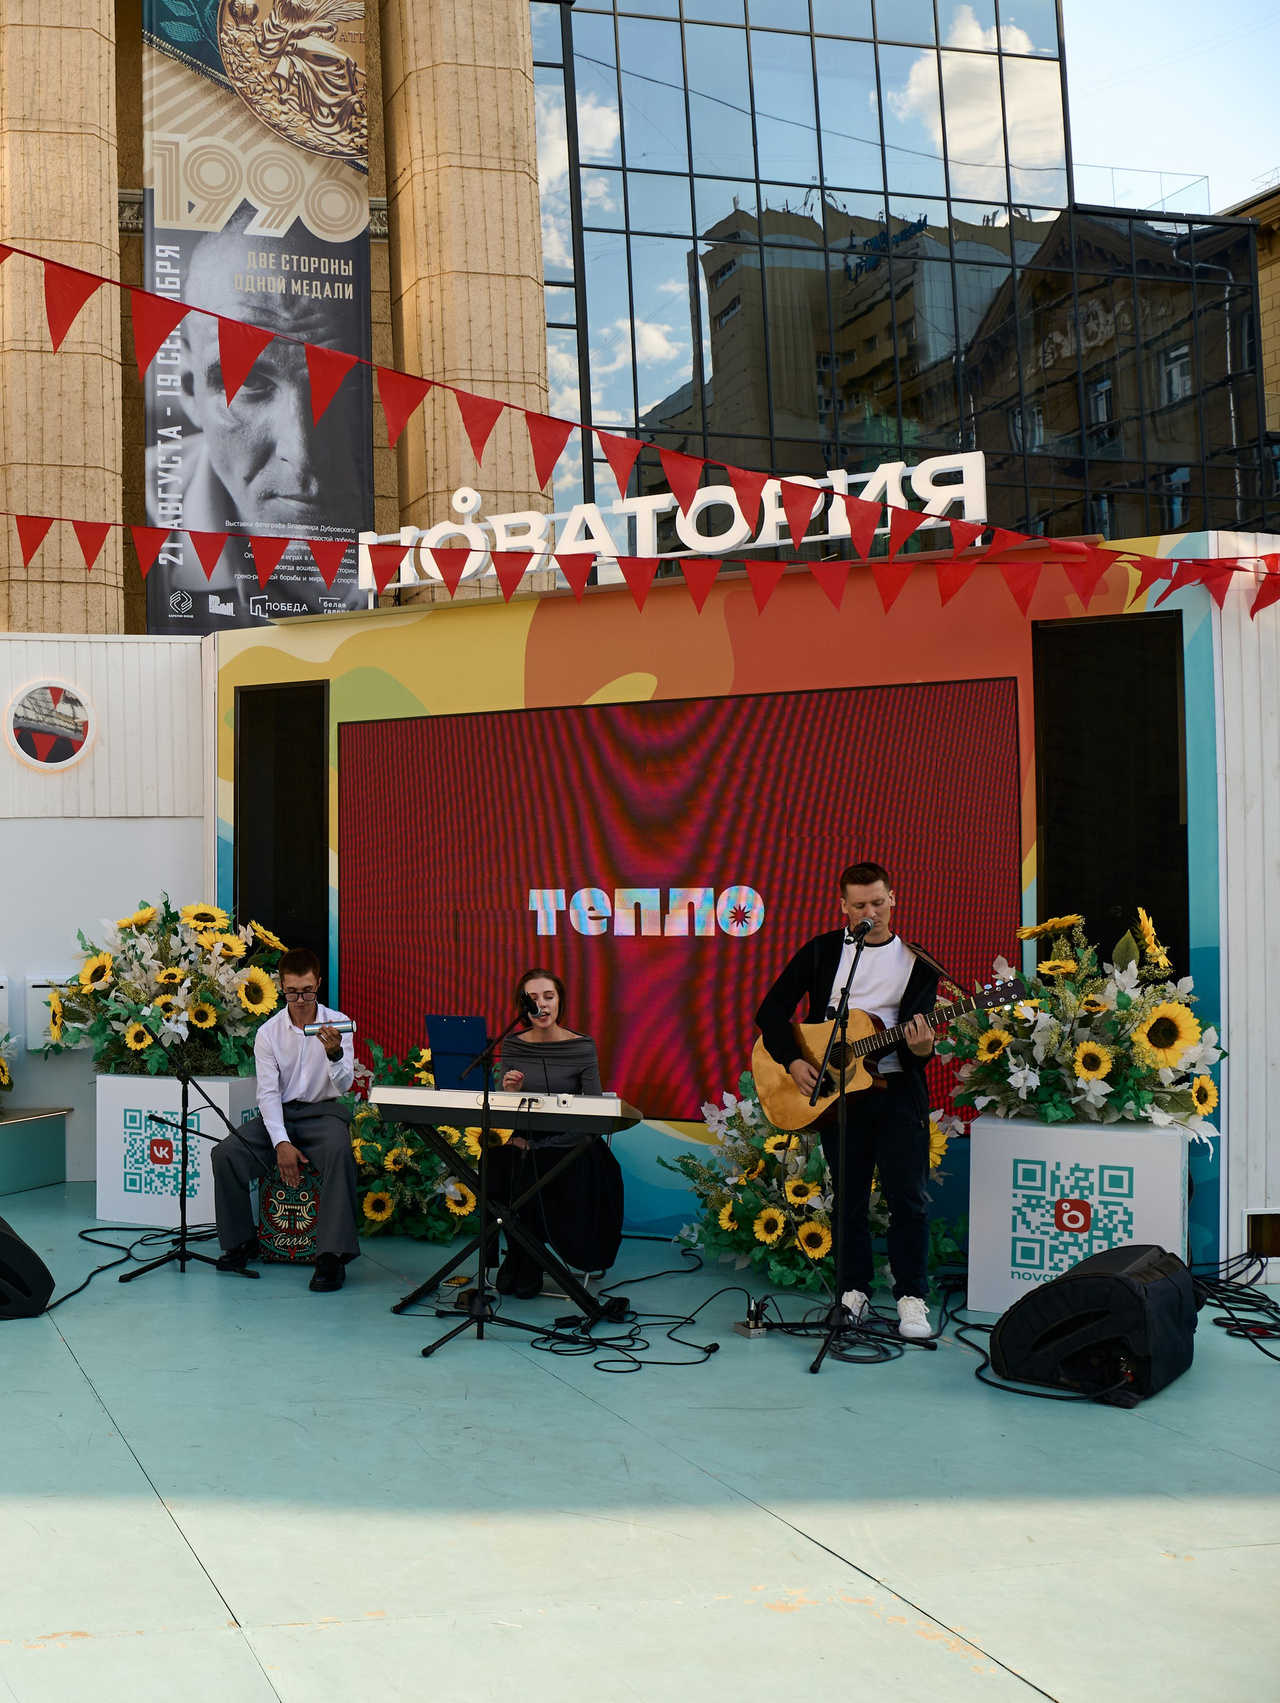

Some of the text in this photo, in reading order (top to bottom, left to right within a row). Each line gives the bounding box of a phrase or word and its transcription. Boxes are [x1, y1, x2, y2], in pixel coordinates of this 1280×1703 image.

[152, 139, 365, 235] 1996
[247, 251, 353, 276] ДВЕ СТОРОНЫ
[234, 274, 354, 299] ОДНОЙ МЕДАЛИ
[157, 373, 182, 397] 19
[157, 425, 184, 530] АВГУСТА
[225, 520, 253, 528] Выставка
[287, 523, 319, 532] Владимира
[320, 525, 356, 534] Дубровского
[265, 601, 309, 613] ПОБЕДА
[323, 601, 347, 609] белая
